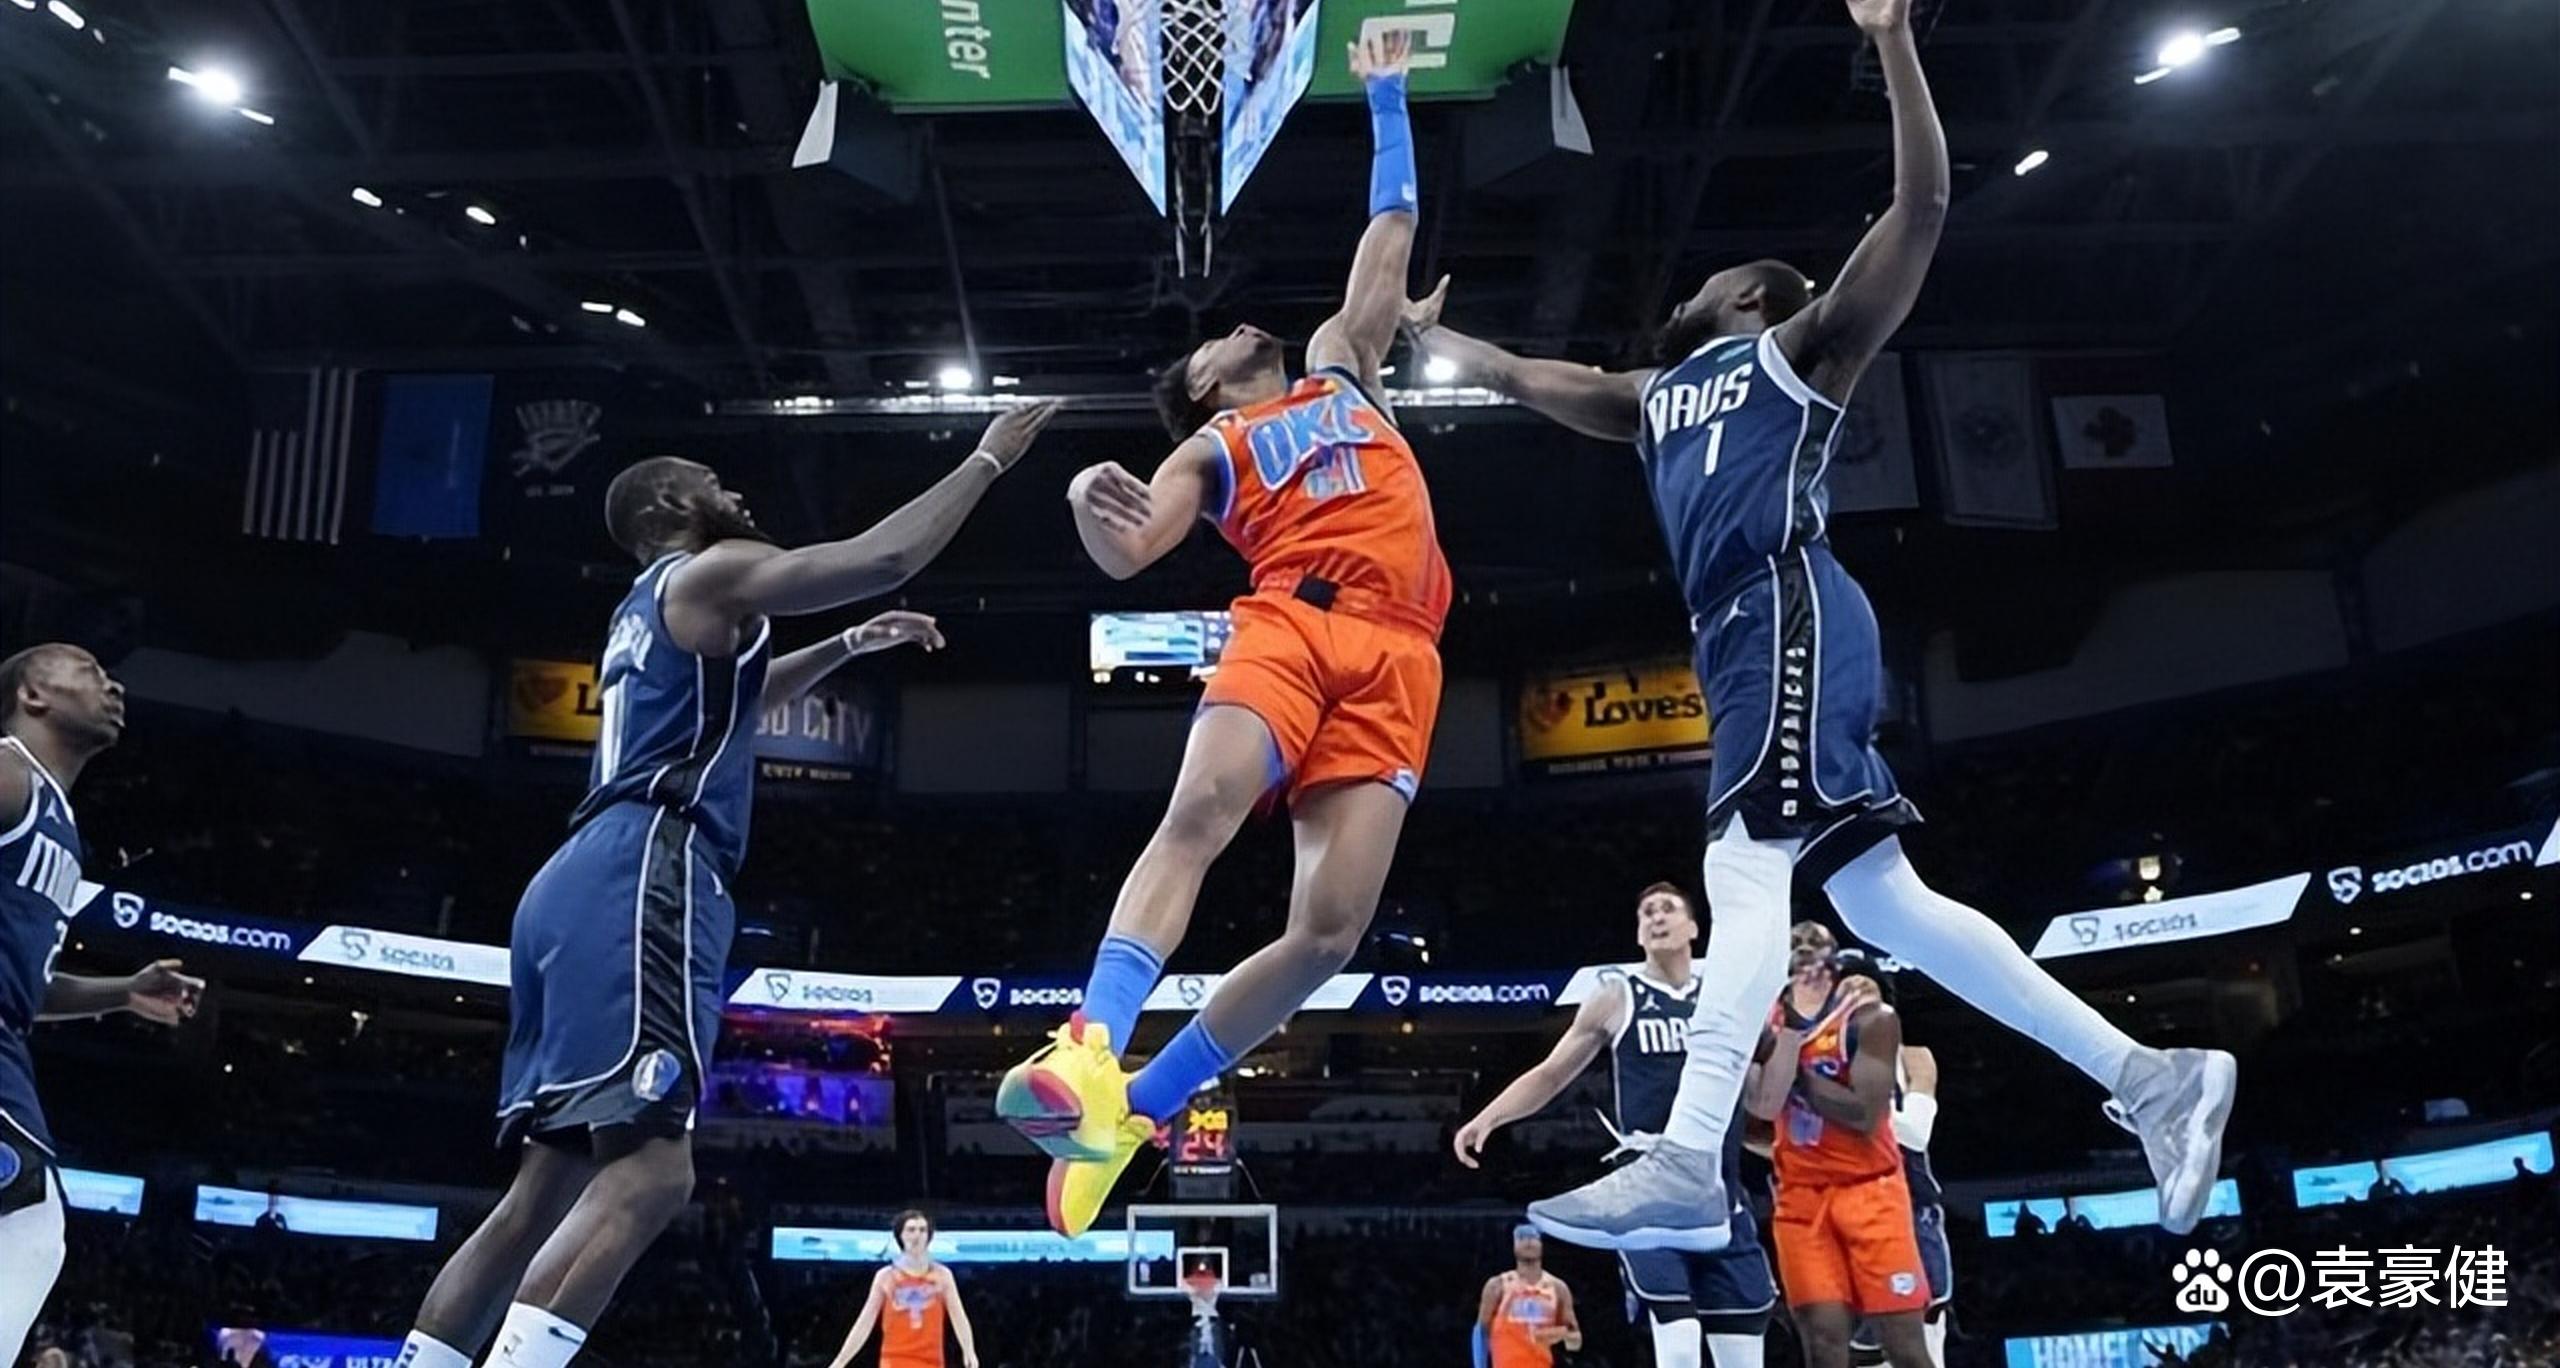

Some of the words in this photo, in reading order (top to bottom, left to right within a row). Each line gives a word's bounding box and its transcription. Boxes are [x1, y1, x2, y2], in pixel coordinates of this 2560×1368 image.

[1247, 392, 1375, 491] OKC
[1704, 420, 1724, 477] 1
[1637, 1017, 1692, 1054] MA
